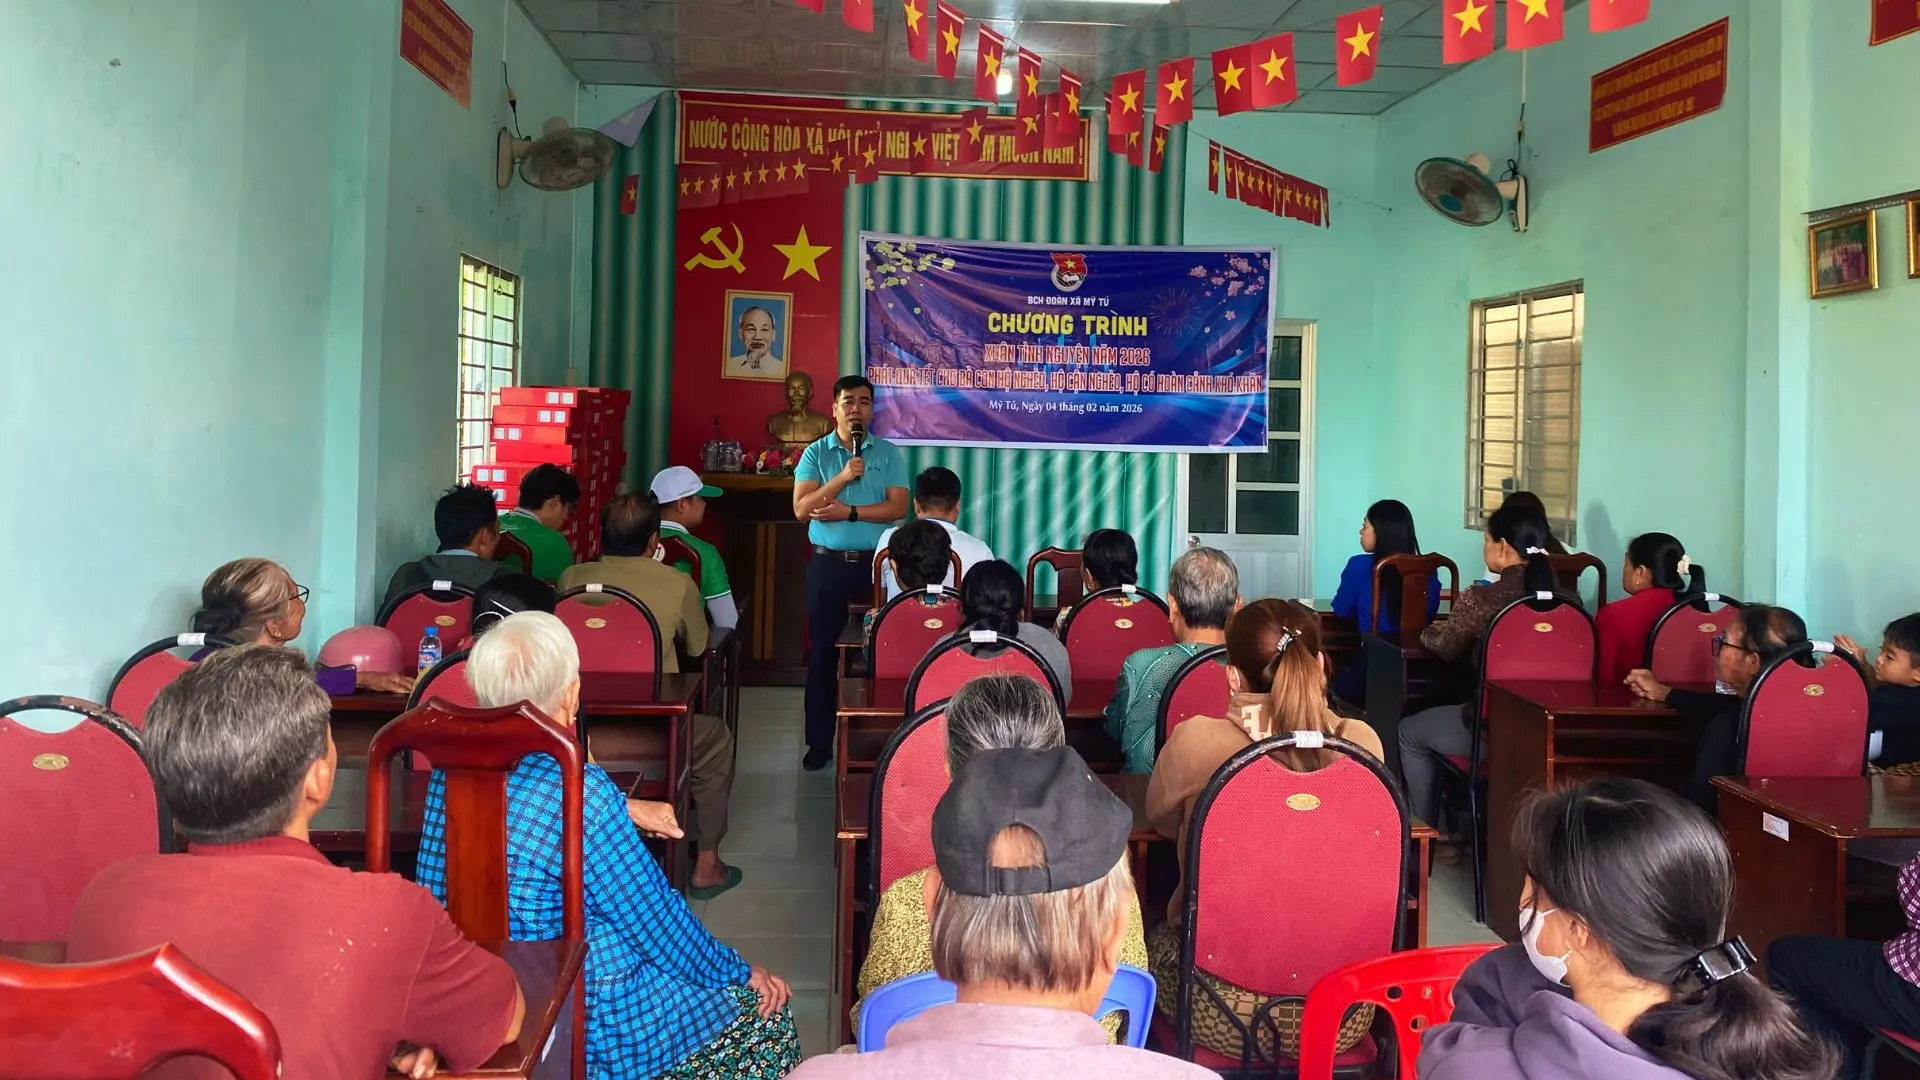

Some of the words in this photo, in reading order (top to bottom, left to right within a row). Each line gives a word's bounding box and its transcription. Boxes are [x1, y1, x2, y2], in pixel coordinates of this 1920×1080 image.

[689, 115, 728, 150] NƯỚC
[731, 117, 770, 158] CỘNG
[773, 118, 801, 152] HÒA
[806, 122, 824, 156] XÃ
[932, 128, 960, 167] VIỆT
[1027, 296, 1043, 305] BCH
[1046, 295, 1068, 306] ĐOÀN
[1070, 296, 1081, 306] XÃ
[1084, 296, 1096, 306] MỸ
[1098, 296, 1109, 307] TÚ
[988, 311, 1074, 336] CHƯƠNG
[1081, 309, 1148, 337] TRÌNH
[984, 341, 1015, 363] XUÂN
[1017, 341, 1043, 364] TÌNH
[1045, 343, 1089, 368] NGUYỆN
[1092, 344, 1117, 366] NĂM
[1119, 347, 1150, 367] 2026
[868, 363, 894, 385] PHÁT
[918, 363, 935, 386] TẾT
[936, 368, 958, 387] CHO
[959, 365, 973, 388] BÀ
[975, 369, 995, 389] CON
[997, 367, 1012, 393] HỘ
[1013, 368, 1049, 393] NGHÈO,
[1051, 369, 1065, 394] HỘ
[1067, 369, 1088, 395] CẬN
[1088, 370, 1125, 396] NGHÈO,
[1125, 370, 1140, 396] HỘ
[1142, 370, 1155, 393] CÓ
[1157, 370, 1184, 393] HOÀN
[1186, 370, 1213, 393] CẢNH
[1215, 371, 1235, 393] KHÓ
[1235, 372, 1262, 394] KHĂN
[988, 400, 1003, 412] Mỹ
[1005, 400, 1019, 411] Tú,
[1021, 401, 1043, 413] Ngày
[1045, 401, 1057, 411] 04
[1059, 401, 1085, 414] tháng
[1086, 402, 1098, 412] 02
[1099, 402, 1119, 413] năm
[1121, 403, 1143, 413] 2026
